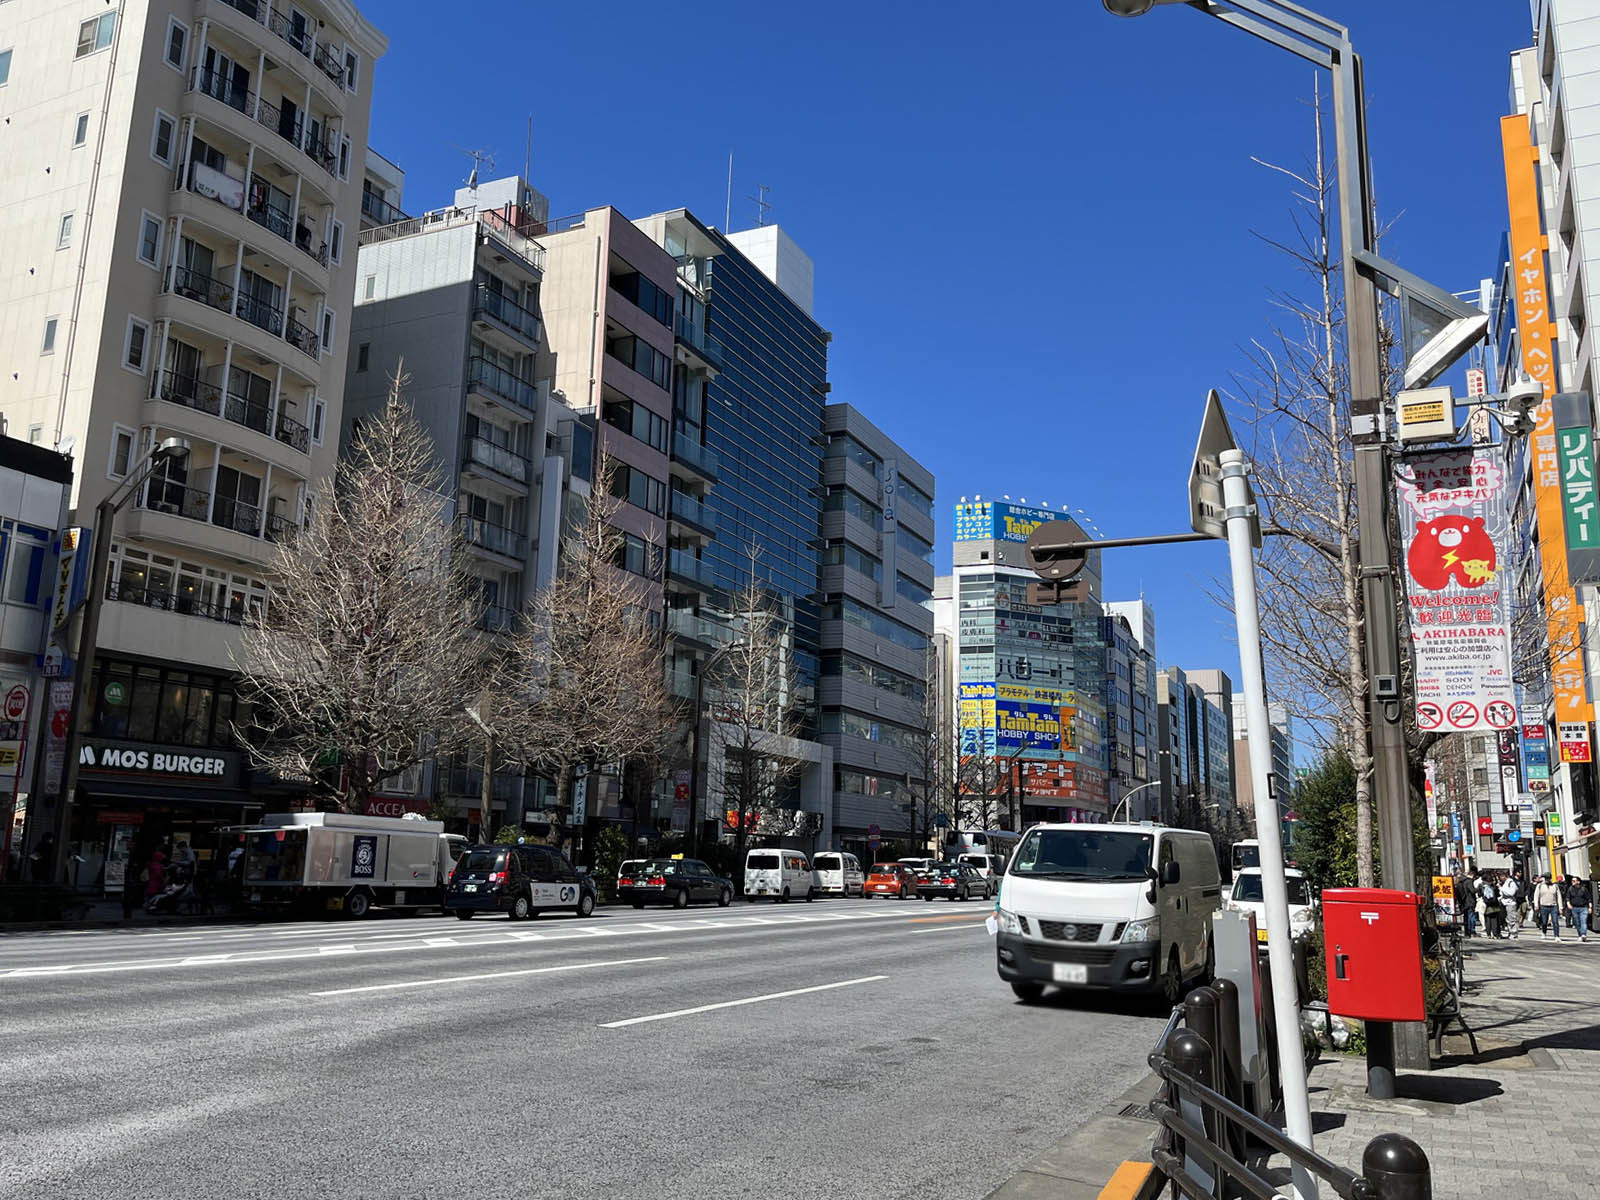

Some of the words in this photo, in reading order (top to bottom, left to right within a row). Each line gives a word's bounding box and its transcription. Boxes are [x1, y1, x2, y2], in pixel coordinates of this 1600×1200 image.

[1416, 465, 1485, 479] みんなで協力
[1563, 434, 1594, 541] リバティー
[1416, 489, 1487, 503] 元気なアキバ
[1409, 591, 1499, 608] Welcome!
[1423, 627, 1505, 639] AKIHABARA
[1425, 652, 1491, 661] www.akiba.or.jp
[997, 710, 1059, 733] TamTam
[997, 729, 1029, 739] HOBBY
[101, 749, 149, 769] MOS
[152, 753, 225, 775] BURGER
[368, 802, 406, 815] ACCEA
[354, 865, 372, 874] BOSS
